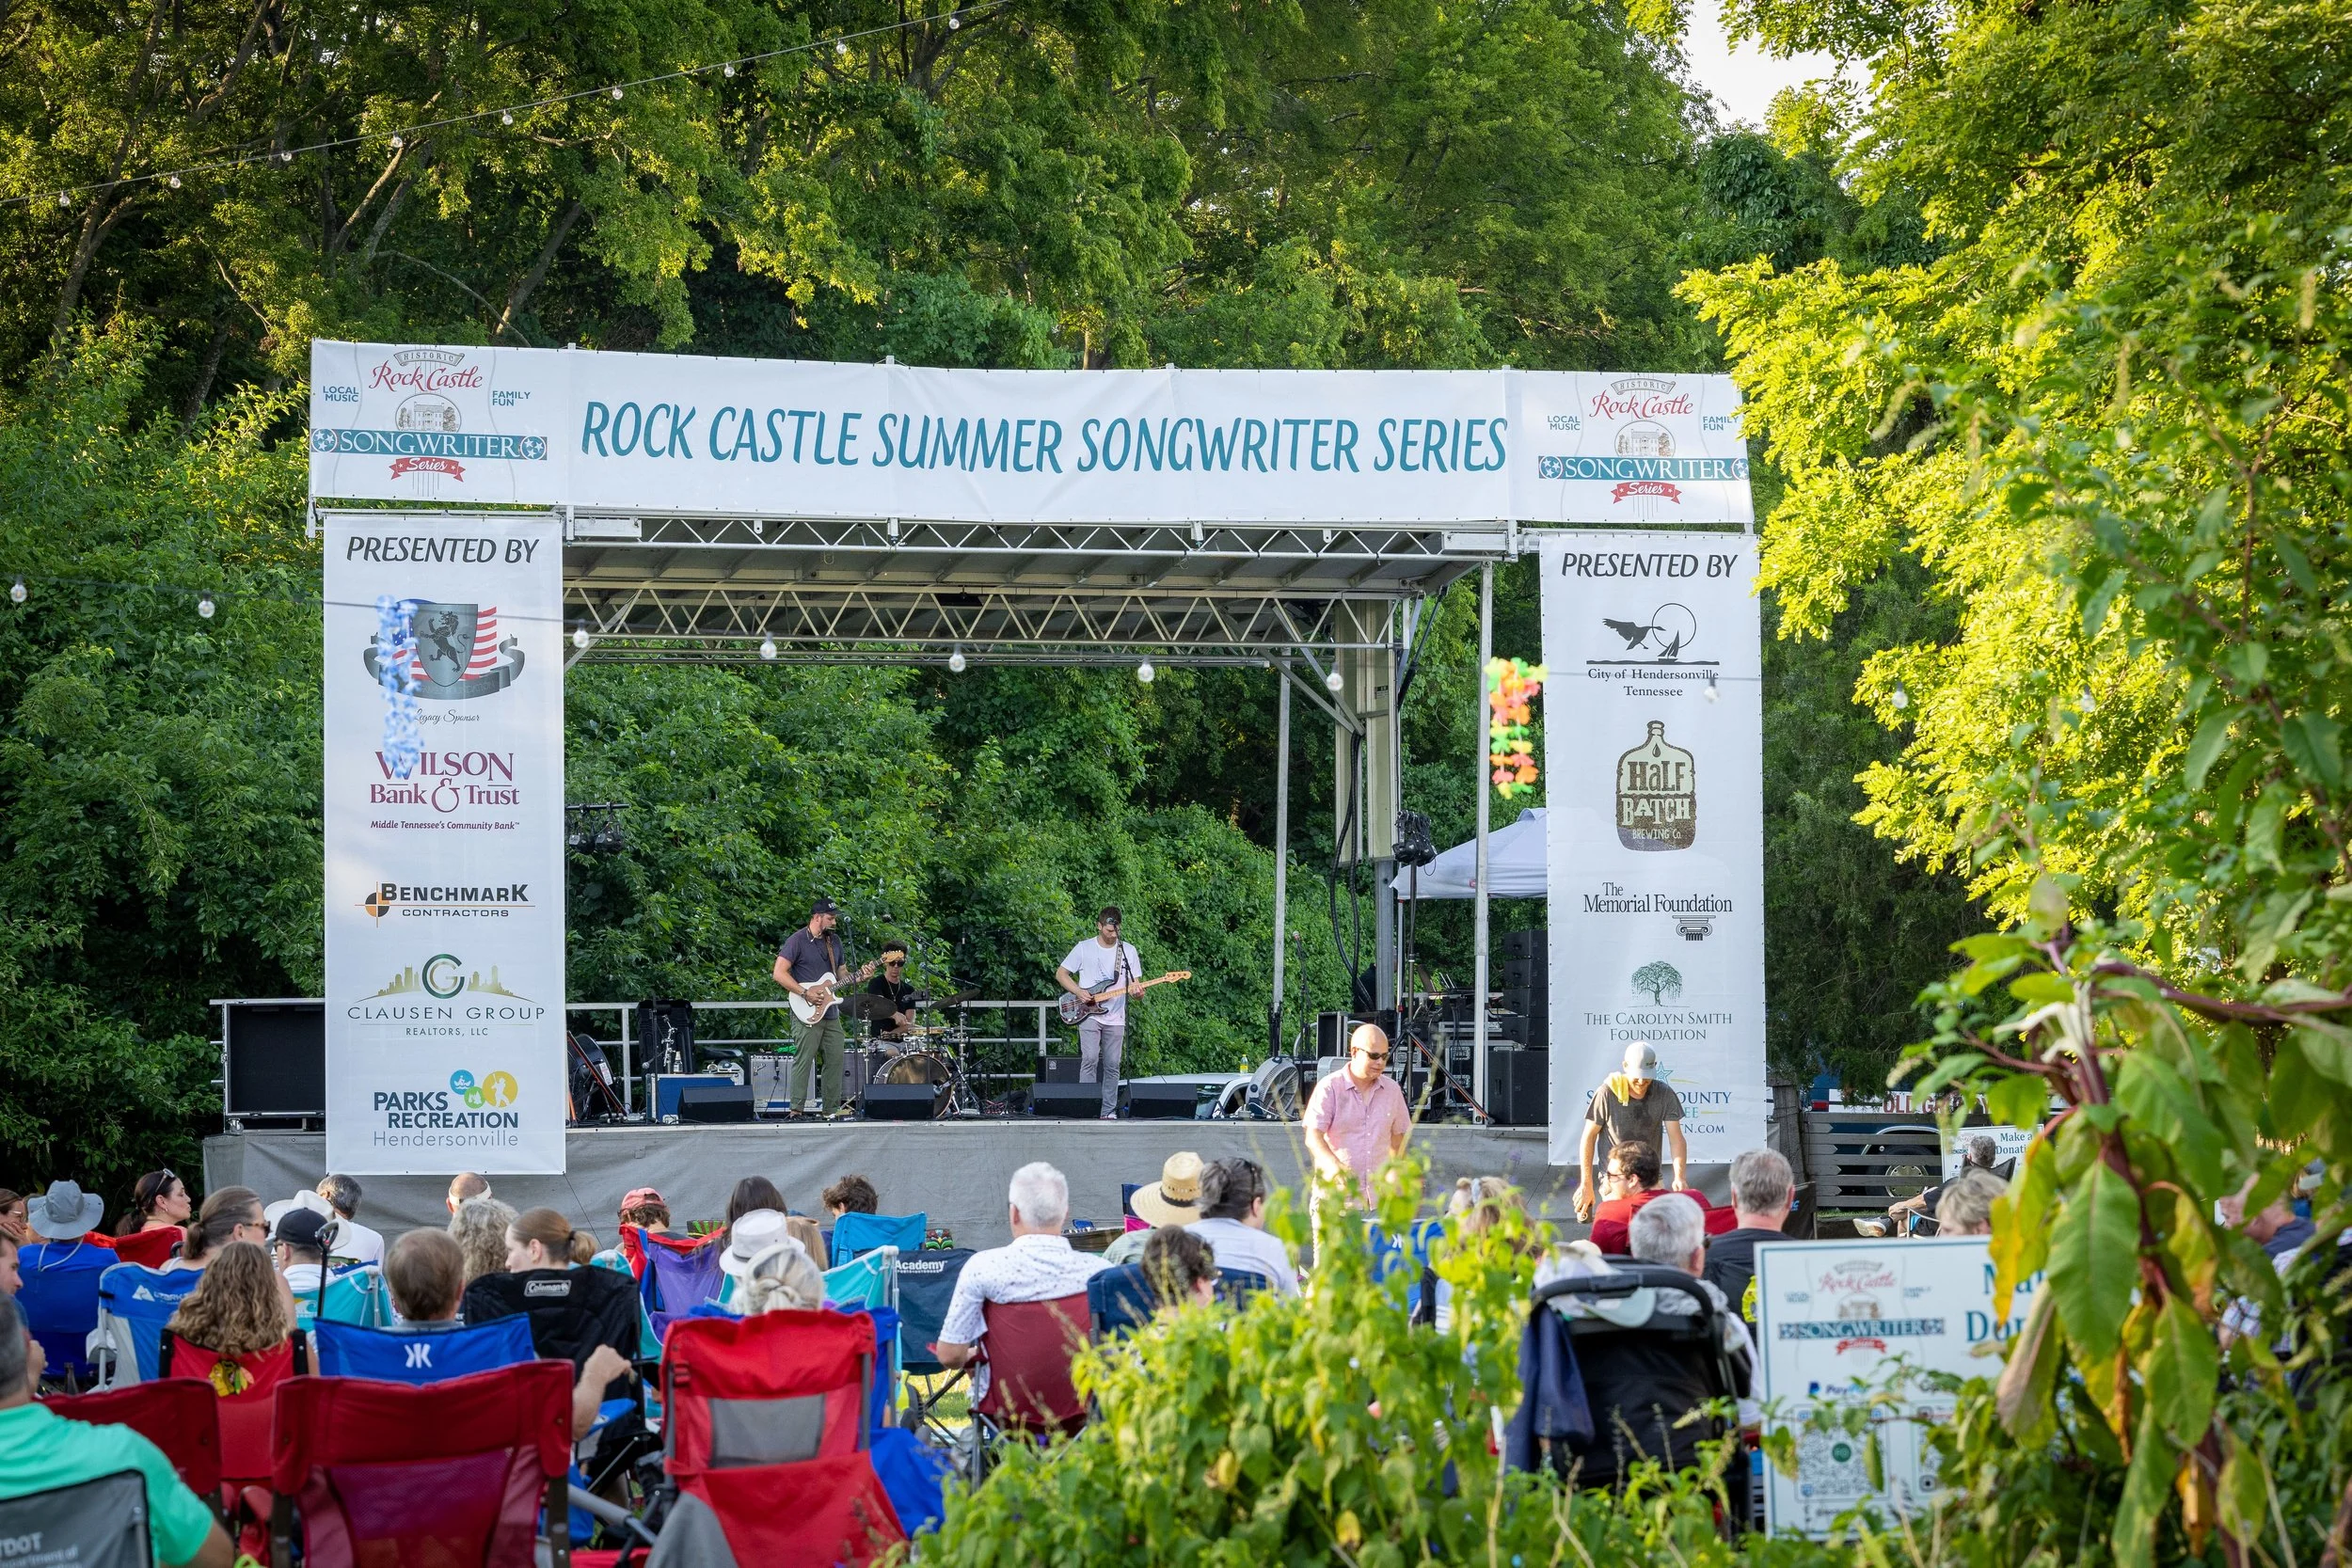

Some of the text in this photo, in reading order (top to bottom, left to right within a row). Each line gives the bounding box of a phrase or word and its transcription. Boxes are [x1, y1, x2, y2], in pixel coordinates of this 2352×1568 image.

[403, 352, 454, 363] HISTORIC
[368, 359, 484, 392] Rock Castle
[323, 386, 359, 395] LOCAL
[1619, 380, 1667, 391] HISTORIC
[325, 393, 359, 403] MUSIC
[492, 390, 532, 400] FAMILY
[492, 398, 515, 406] FUN
[1589, 389, 1693, 420] Rock Castle
[1547, 416, 1581, 424] LOCAL
[1549, 422, 1581, 431] MUSIC
[1703, 416, 1739, 424] FAMILY
[1703, 423, 1724, 432] FUN
[581, 401, 1509, 473] ROCK CASTLE SUMMER SONGWRITER SERIES
[340, 430, 520, 458] SONGWRITER
[406, 457, 448, 471] Series
[1565, 457, 1733, 480] SONGWRITER
[1627, 482, 1665, 495] Series
[346, 536, 540, 563] PRESENTED BY
[1561, 552, 1739, 578] PRESENTED BY
[1587, 669, 1720, 682] City of Hendersonville
[1623, 686, 1683, 697] Tennessee
[443, 708, 480, 724] Sponsor
[370, 778, 520, 813] Bank & Trust
[1621, 798, 1692, 826] BATCH
[371, 820, 399, 829] Middle
[401, 820, 445, 830] Tennessee's
[447, 821, 493, 832] Community
[1632, 829, 1670, 839] BREWING
[381, 882, 530, 902] BENCHMARK
[1602, 881, 1624, 896] The
[1583, 894, 1733, 913] Memorial Foundation
[402, 909, 509, 917] CONTRACTORS
[347, 1006, 546, 1021] CLAUSEN GROUP
[1584, 1011, 1732, 1025] THE CAROLYN SMITH
[405, 1027, 488, 1037] REALTORS, LLC
[1610, 1028, 1707, 1040] FOUNDATION
[373, 1091, 449, 1112] PARKS
[1677, 1091, 1732, 1104] OUNTY
[388, 1112, 518, 1129] RECREATION
[373, 1130, 519, 1148] Hendersonville
[2000, 1132, 2025, 1142] Make
[1996, 1146, 2026, 1154] Donati
[896, 1259, 945, 1272] Academy
[1799, 1320, 1925, 1338] SONGWRITER
